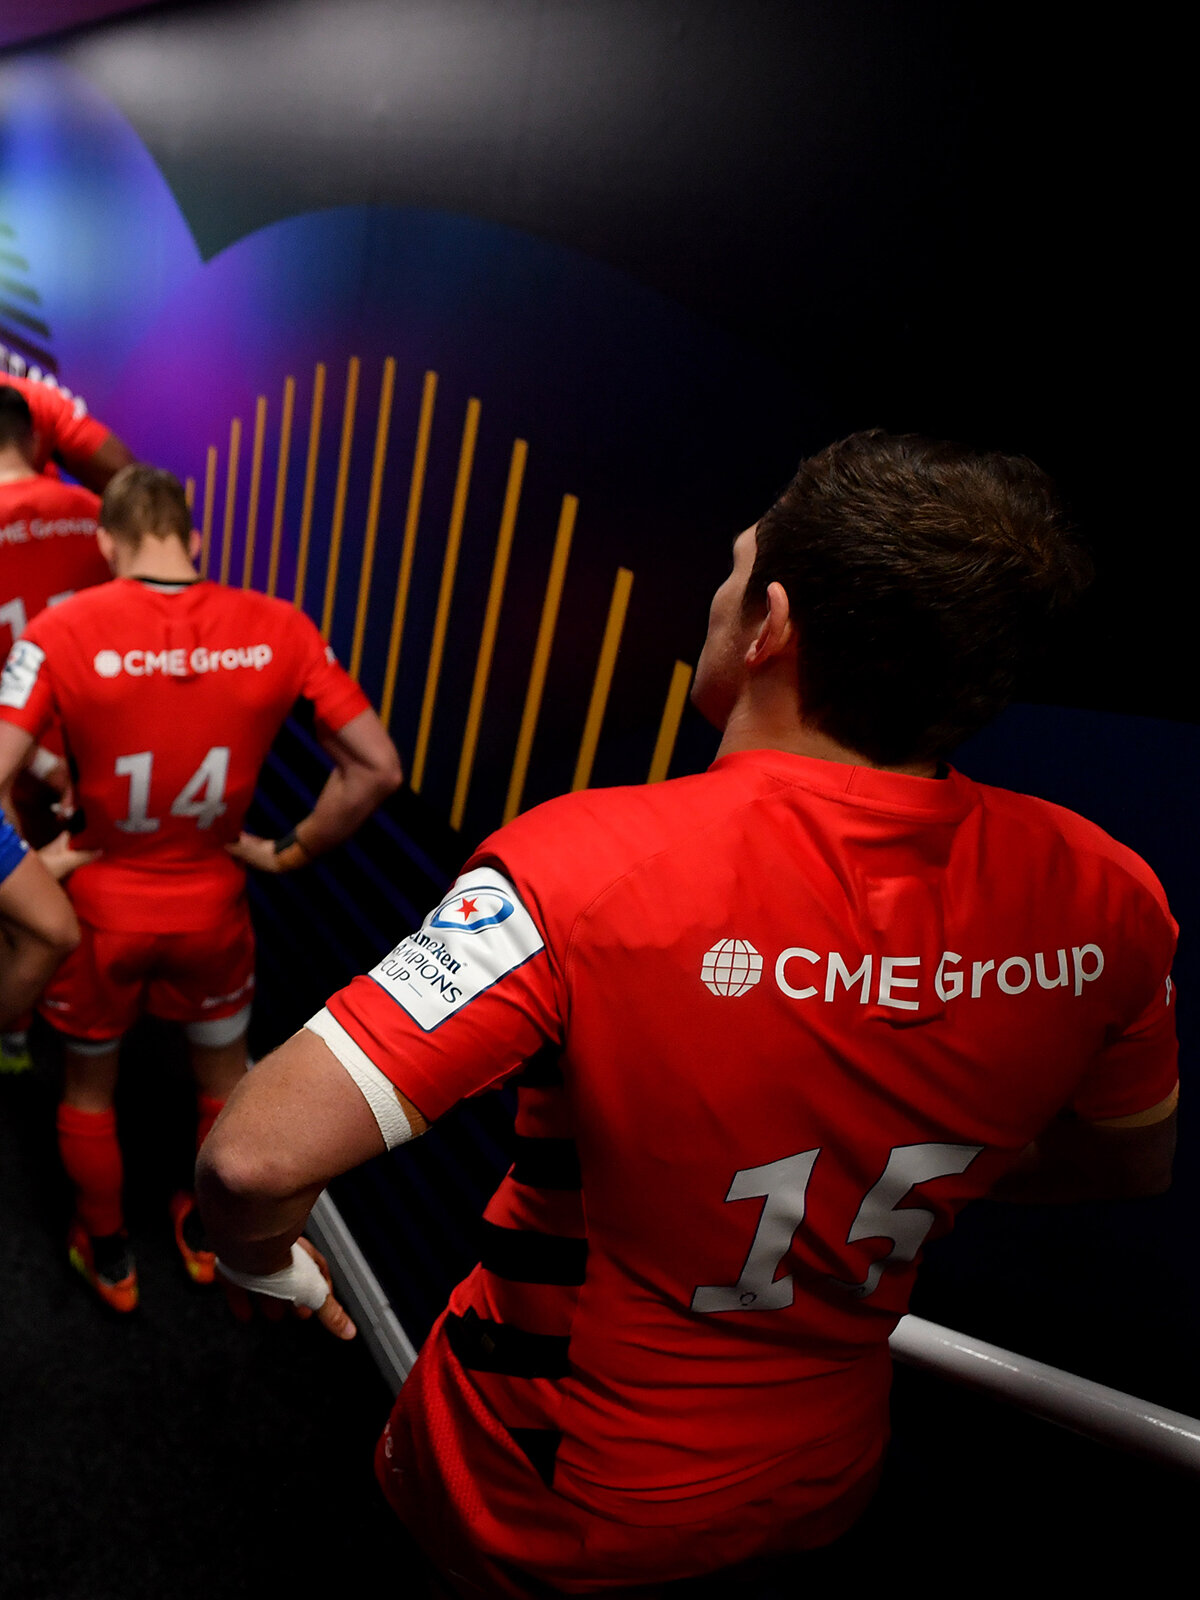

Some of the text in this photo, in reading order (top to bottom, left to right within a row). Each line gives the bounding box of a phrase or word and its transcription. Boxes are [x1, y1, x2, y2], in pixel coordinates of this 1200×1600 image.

[123, 644, 273, 677] CME Group
[115, 746, 230, 833] 14
[380, 959, 411, 982] CUP
[392, 942, 463, 1004] AMPIONS
[774, 946, 921, 1011] CME
[935, 943, 1105, 999] Group
[690, 1143, 984, 1314] 15
